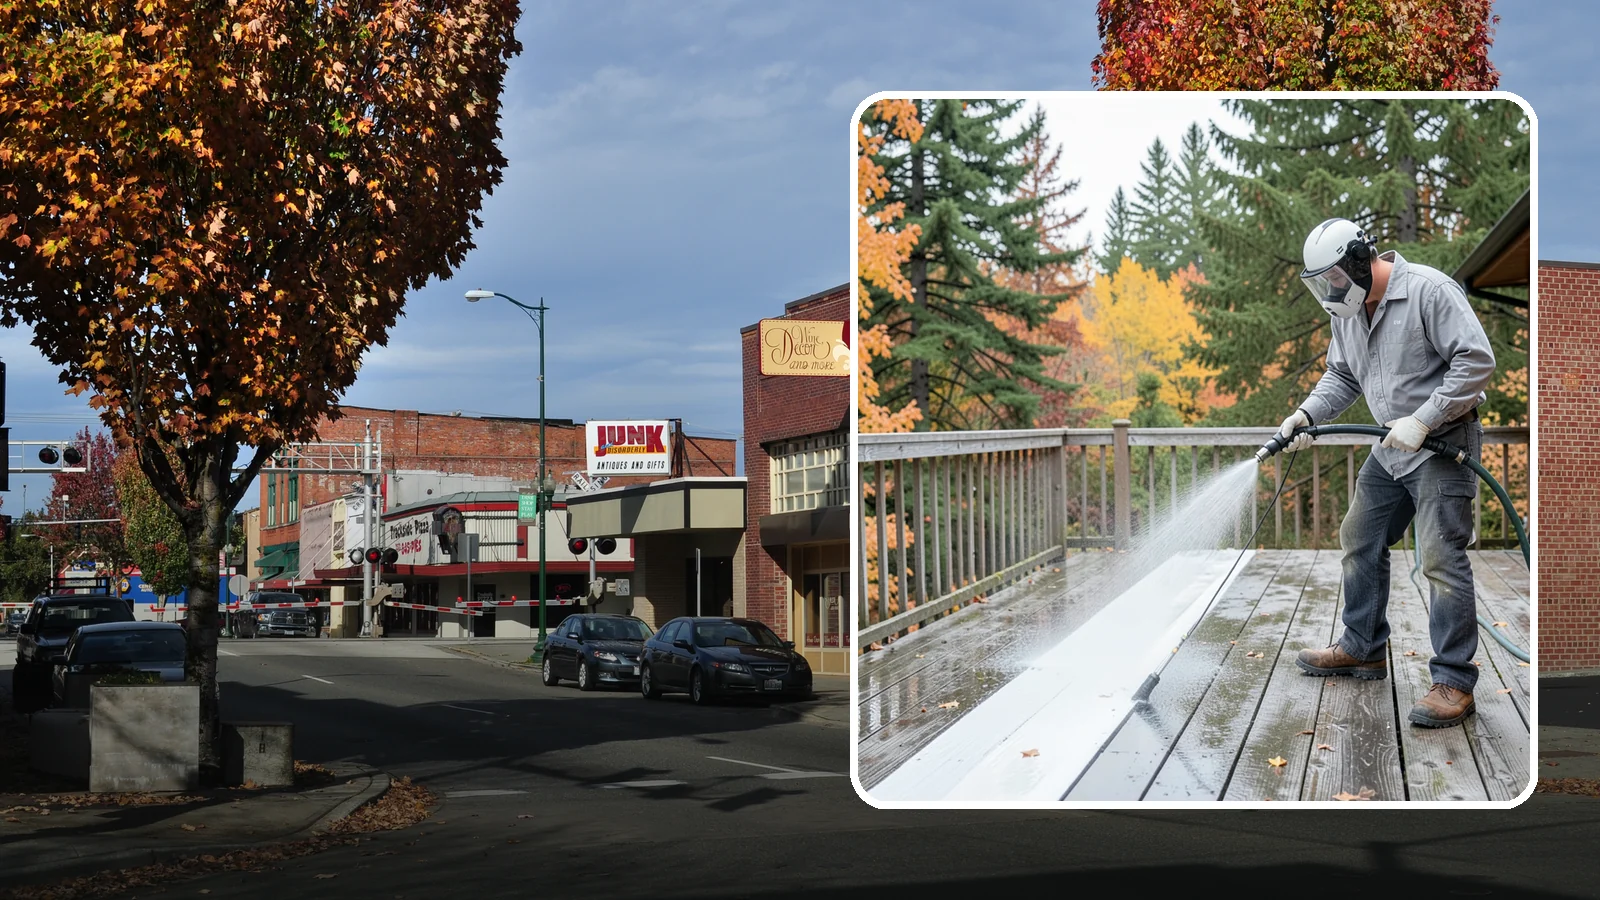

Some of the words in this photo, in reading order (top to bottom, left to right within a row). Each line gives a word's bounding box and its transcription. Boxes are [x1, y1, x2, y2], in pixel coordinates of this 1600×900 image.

[595, 425, 664, 457] JUNK
[607, 446, 645, 454] DISORDERLY
[597, 461, 628, 470] ANTIQUES
[631, 461, 643, 470] AND
[647, 460, 665, 470] GIFTS
[352, 498, 364, 511] CRO
[390, 521, 413, 540] Trackside
[414, 519, 429, 535] Pizza
